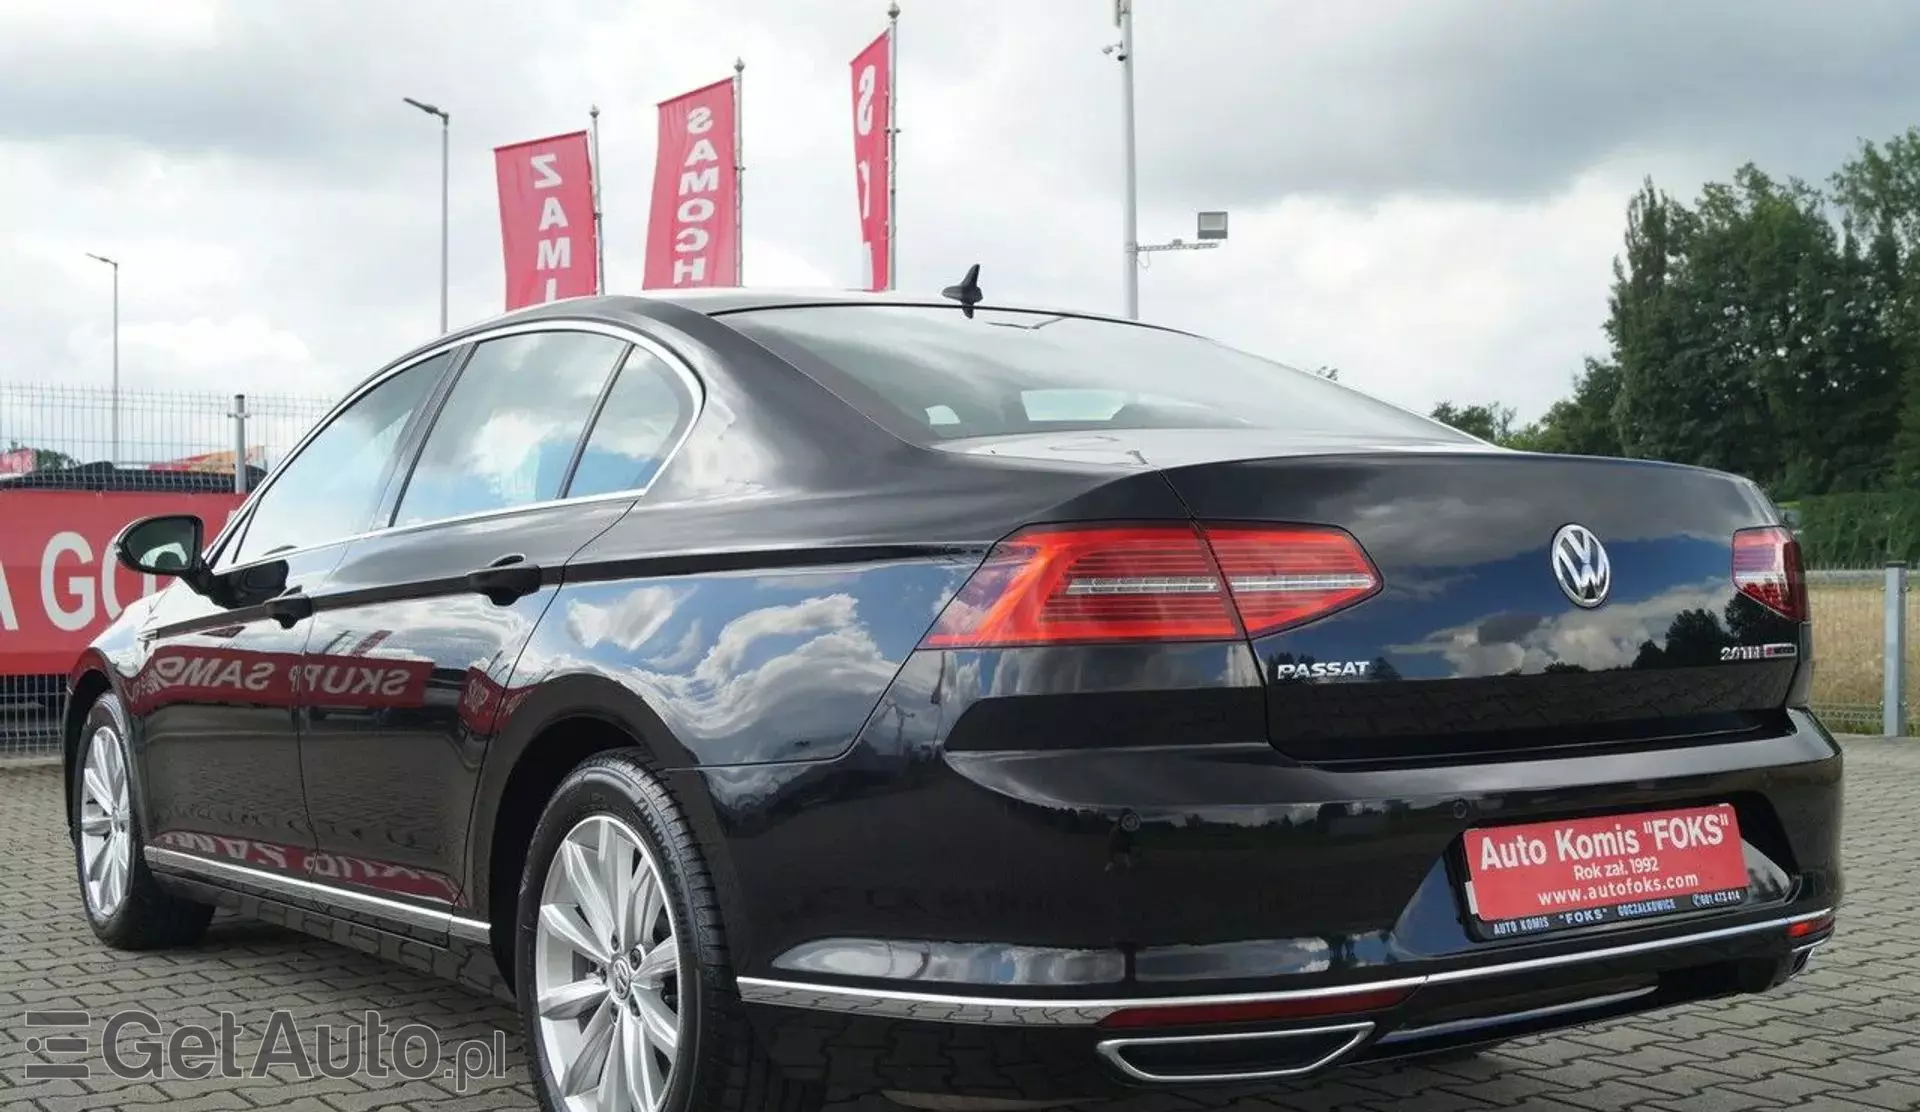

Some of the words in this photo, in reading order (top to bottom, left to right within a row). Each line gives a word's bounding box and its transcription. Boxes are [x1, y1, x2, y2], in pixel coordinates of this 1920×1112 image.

[1277, 661, 1370, 680] PASSAT
[1481, 834, 1548, 870] Auto
[1554, 823, 1641, 862] Komis
[1644, 813, 1729, 851] "FOKS"
[1573, 863, 1602, 881] Rok
[1630, 856, 1660, 874] 1992
[1536, 872, 1699, 906] www.autofoks.com
[1493, 921, 1518, 936] AUTO
[1520, 916, 1550, 931] KOMIS
